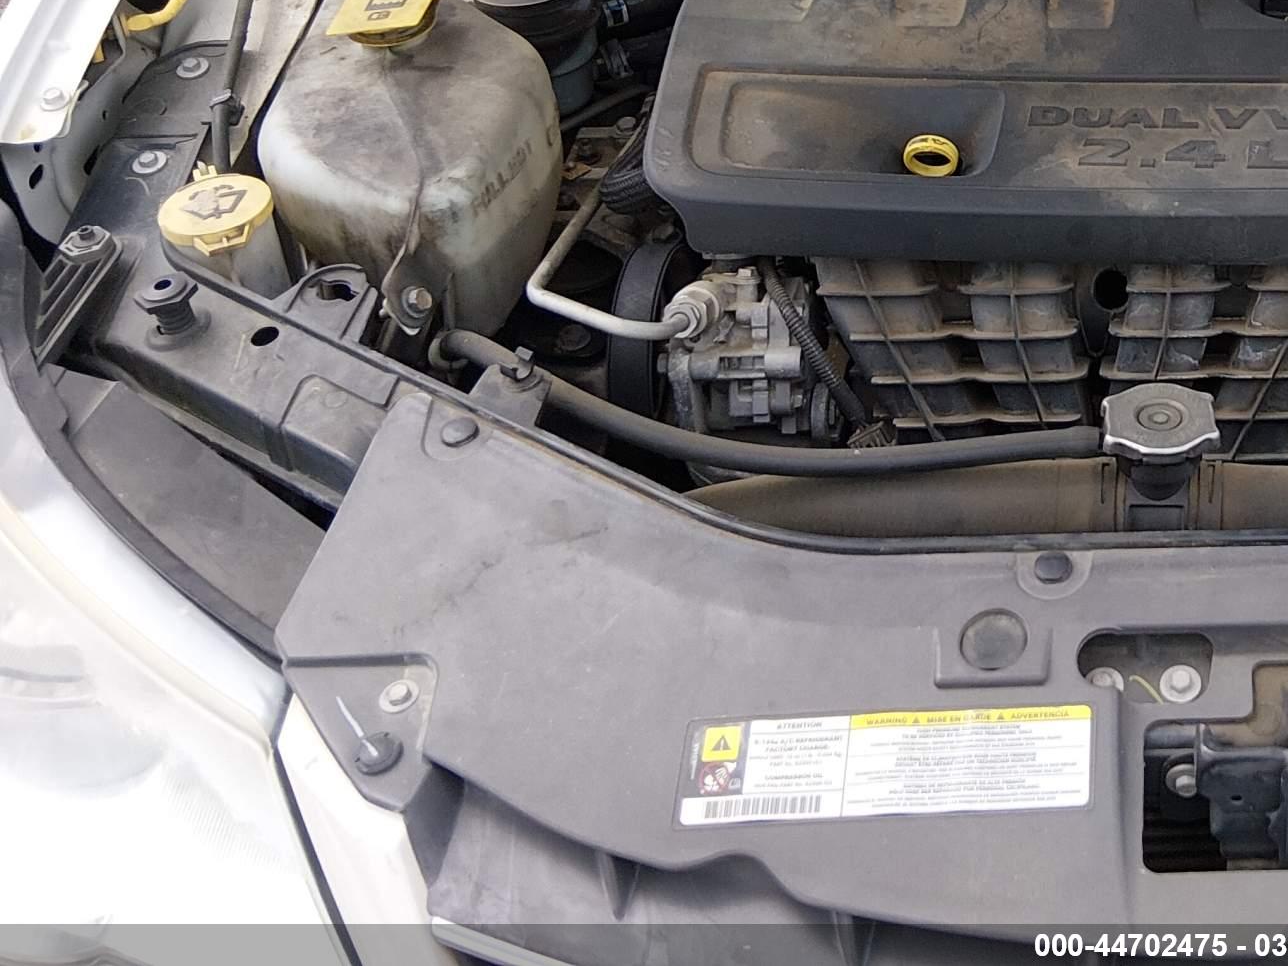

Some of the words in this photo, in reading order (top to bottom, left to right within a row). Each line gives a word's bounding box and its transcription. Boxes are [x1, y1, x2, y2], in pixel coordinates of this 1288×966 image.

[1027, 105, 1200, 129] DUAL
[867, 716, 908, 725] WARNING
[927, 715, 948, 724] MISE
[950, 714, 961, 723] EN
[1011, 710, 1070, 720] ADVERTENCIA
[777, 721, 823, 730] ATTENTION
